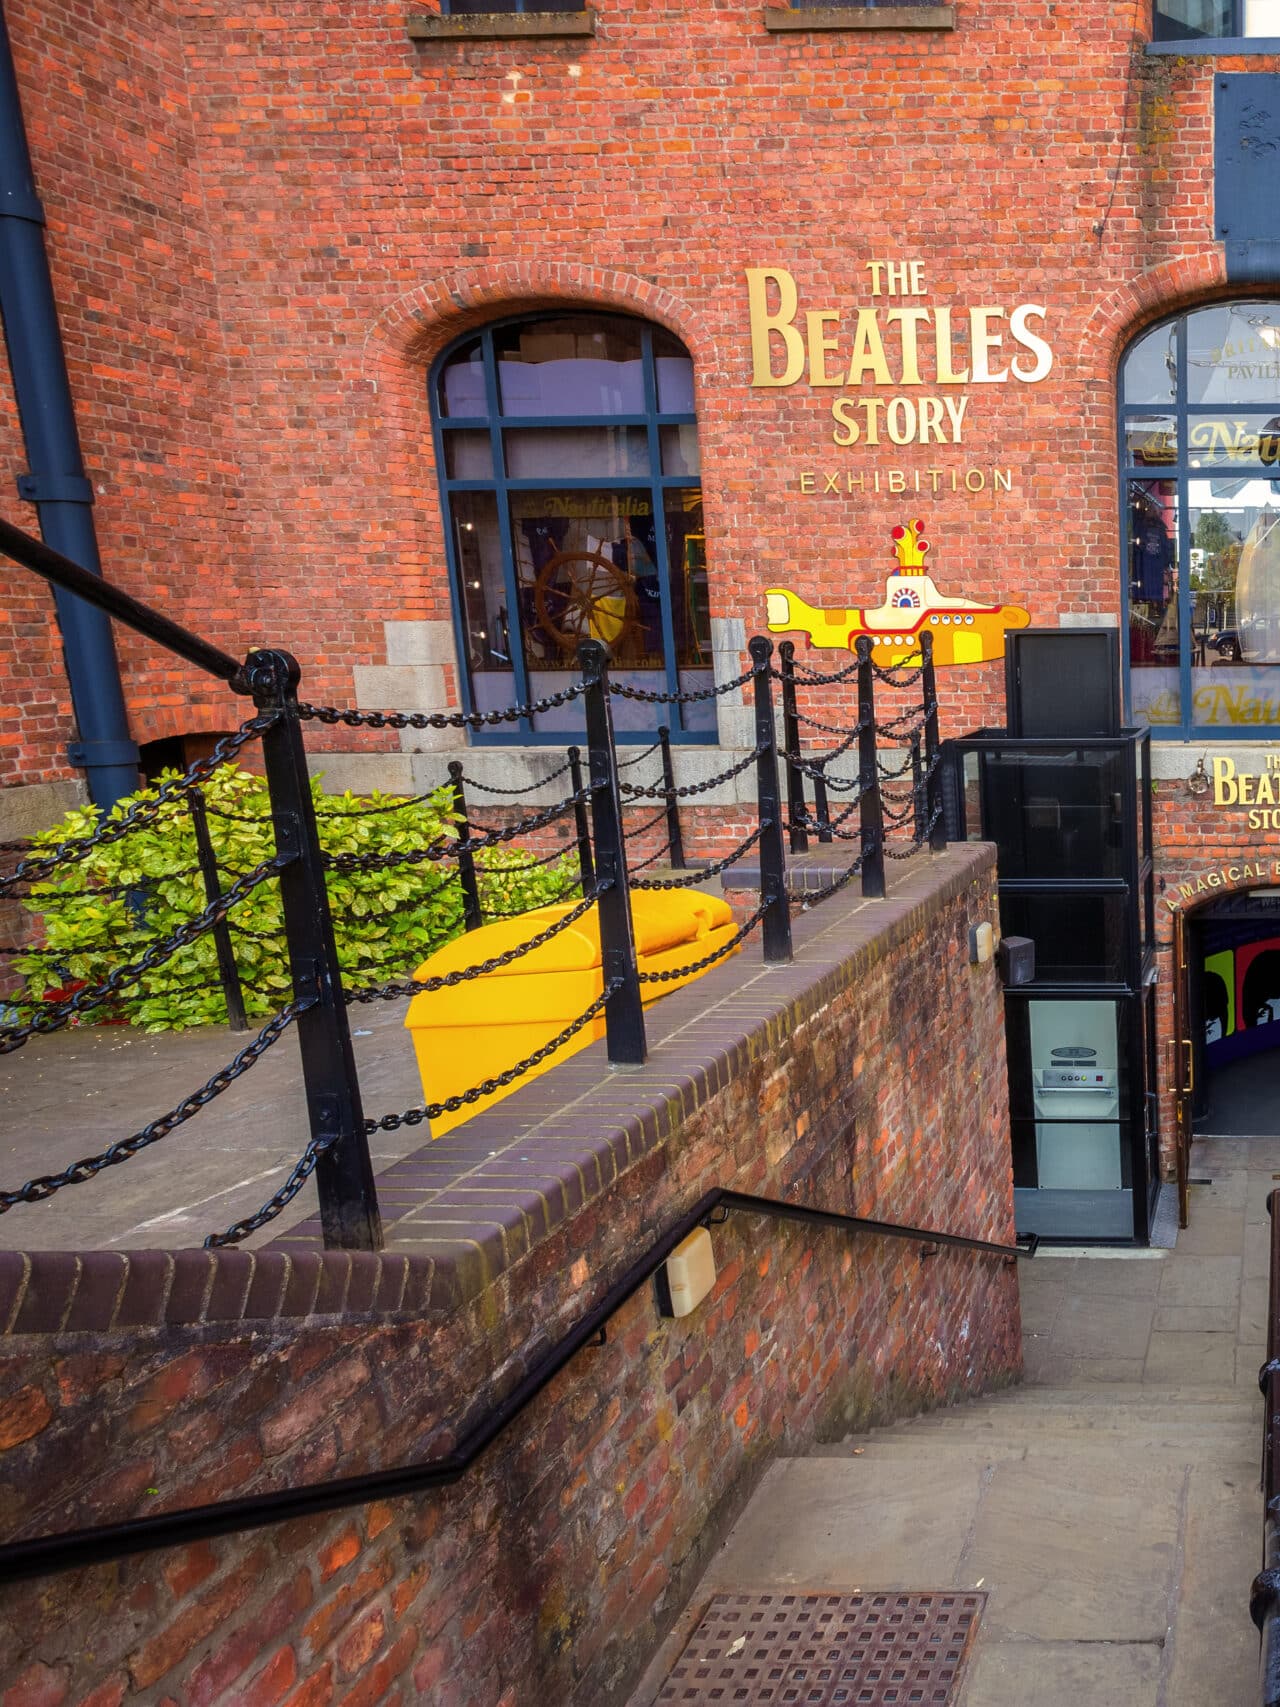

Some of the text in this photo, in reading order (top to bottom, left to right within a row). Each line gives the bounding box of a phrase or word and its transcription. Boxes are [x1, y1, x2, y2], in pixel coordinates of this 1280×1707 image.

[866, 261, 928, 296] THE
[745, 267, 1053, 388] BEATLES
[831, 396, 969, 446] STORY
[799, 469, 1012, 494] EXHIBITION
[1165, 899, 1180, 912] A
[1179, 862, 1266, 900] MAGICAL
